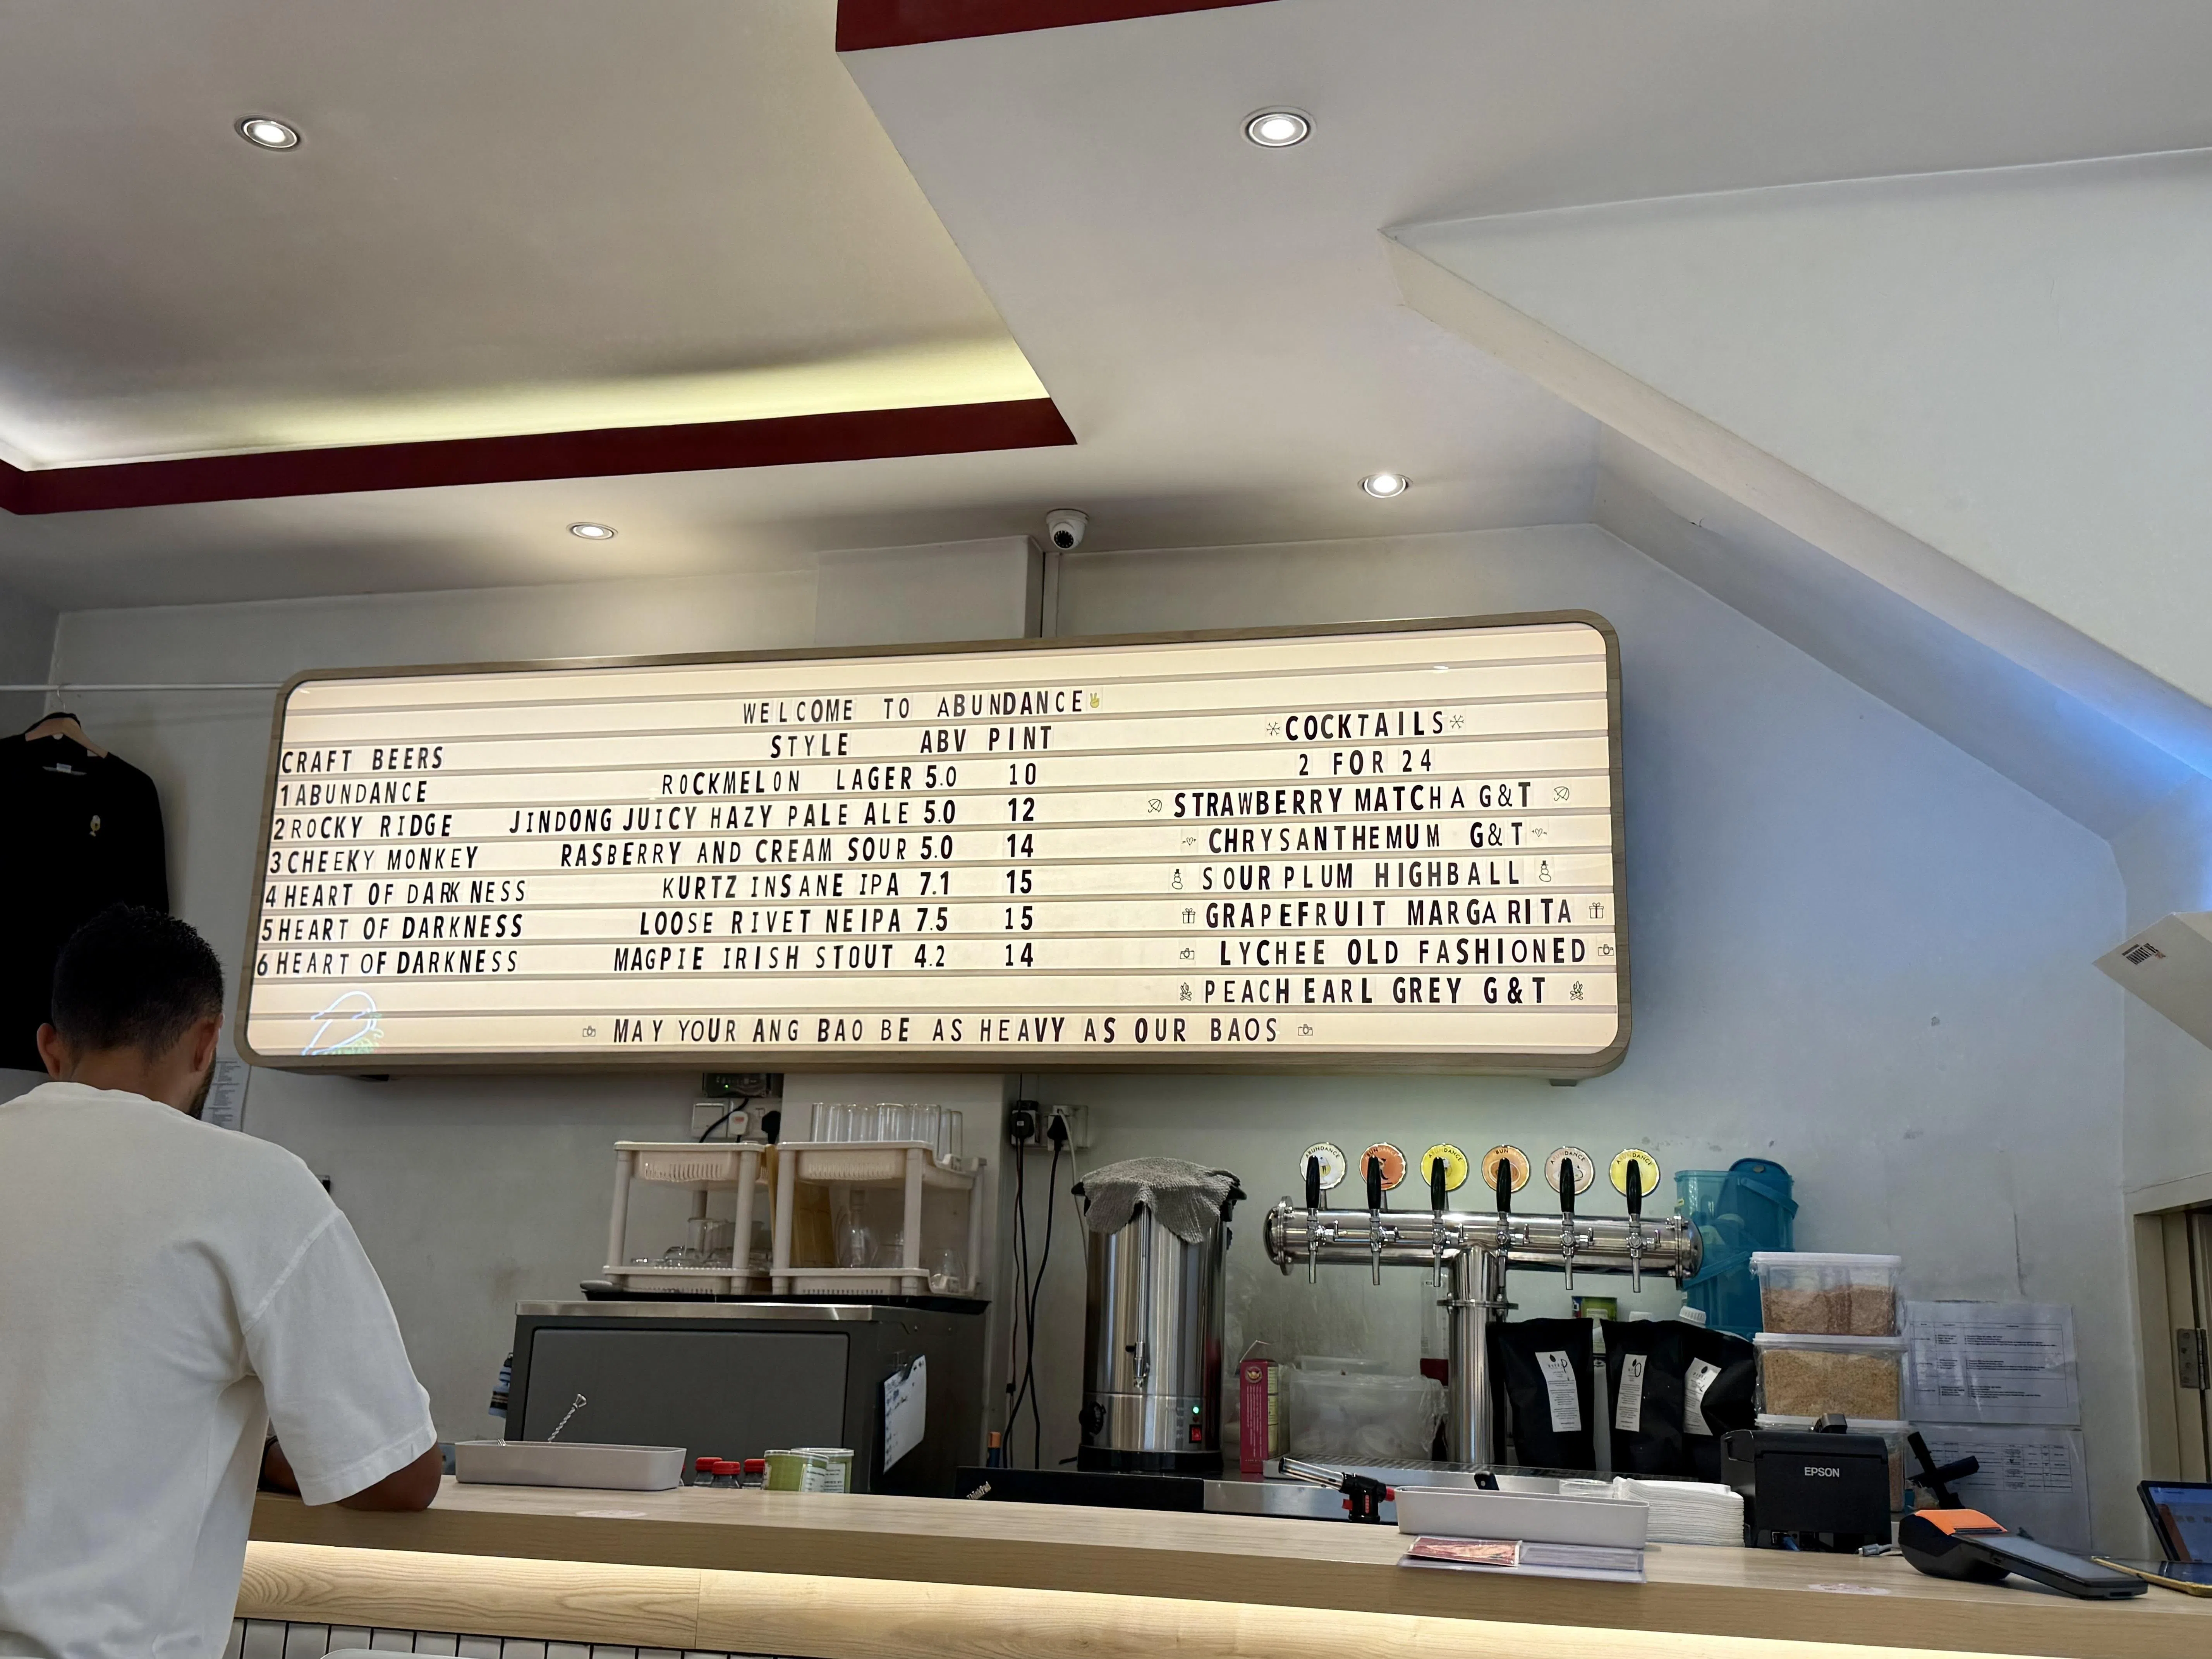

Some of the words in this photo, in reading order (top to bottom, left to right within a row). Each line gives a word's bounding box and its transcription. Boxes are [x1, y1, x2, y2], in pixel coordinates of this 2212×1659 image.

[744, 699, 852, 724] WELCOME
[884, 698, 909, 719] TO
[937, 690, 1082, 717] ABUNDANCE
[1286, 711, 1443, 741] COCKTAILS
[770, 733, 848, 759] STYLE
[920, 729, 966, 753] ABV
[989, 725, 1051, 751] PINT
[282, 750, 352, 773] CRAFT
[372, 746, 443, 770] BEERS
[1299, 753, 1308, 776] 2
[1334, 750, 1384, 775] FOR
[1402, 749, 1431, 772] 24
[662, 770, 799, 795] ROCKMELON
[837, 766, 911, 790] LAGER
[925, 764, 956, 788] 5.0
[1010, 763, 1036, 785] 10
[295, 780, 427, 806] ABUNDANCE
[1174, 788, 1342, 818] STRAWBERRY
[1355, 785, 1465, 812] MATCHA
[1479, 782, 1531, 807] G&T
[509, 808, 611, 833] JINDONG
[623, 806, 697, 831] JUICY
[711, 805, 772, 829] HAZY
[788, 803, 847, 827] PALE
[864, 802, 909, 825] ALE
[924, 800, 955, 824] 5.0
[1008, 797, 1034, 821] 12
[291, 816, 362, 839] ROCKY
[380, 813, 452, 837] RIDGE
[1209, 824, 1439, 854] CHRYSANTHEMUM
[1470, 822, 1523, 848] G&T
[561, 842, 681, 867] RASBERRY
[697, 841, 740, 864] AND
[756, 838, 831, 863] CREAM
[848, 837, 906, 861] SOUR
[921, 835, 953, 860] 5.0
[1007, 833, 1033, 857] 14
[288, 850, 374, 874] CHEEKY
[387, 846, 478, 870] MONKEY
[663, 875, 737, 900] KURTZ
[751, 873, 843, 898] INSANE
[859, 872, 898, 896] IPA
[921, 871, 949, 895] 7.1
[1006, 869, 1032, 894] 15
[1203, 865, 1270, 890] SOUR
[1285, 863, 1352, 889] PLUM
[1376, 860, 1519, 888] HIGHBALL
[285, 883, 353, 908] HEART
[368, 883, 393, 905] OF
[407, 880, 525, 904] DARKNESS
[640, 911, 713, 935] LOOSE
[732, 909, 811, 934] RIVET
[826, 908, 900, 933] NEIPA
[917, 907, 948, 931] 7.5
[1005, 905, 1033, 931] 15
[1206, 900, 1385, 928] GRAPEFRUIT
[1408, 898, 1571, 926] MARGARITA
[278, 918, 349, 941] HEART
[363, 917, 389, 940] OF
[402, 914, 522, 939] DARKNESS
[276, 952, 349, 974] HEART
[361, 951, 387, 974] OF
[397, 949, 517, 974] DARKNESS
[614, 946, 704, 971] MAGPIE
[723, 945, 799, 970] IRISH
[816, 944, 893, 969] STOUT
[914, 944, 945, 968] 4.2
[1005, 943, 1033, 967] 14
[1221, 939, 1324, 966] LYCHEE
[1348, 939, 1398, 965] OLD
[1420, 937, 1585, 965] FASHIONED
[1205, 978, 1289, 1004] PEACH
[1305, 977, 1372, 1003] EARL
[1393, 977, 1462, 1004] GREY
[1484, 977, 1545, 1004] G&T
[613, 1019, 663, 1042] MAY
[678, 1018, 735, 1042] YOUR
[752, 1018, 798, 1042] ANG
[817, 1018, 862, 1042] BAO
[881, 1017, 909, 1042] BE
[933, 1018, 962, 1042] AS
[980, 1017, 1065, 1042] HEAVY
[1084, 1017, 1116, 1043] AS
[1135, 1018, 1186, 1043] OUR
[1211, 1018, 1276, 1042] BAOS
[1804, 1467, 1840, 1477] EPSON
